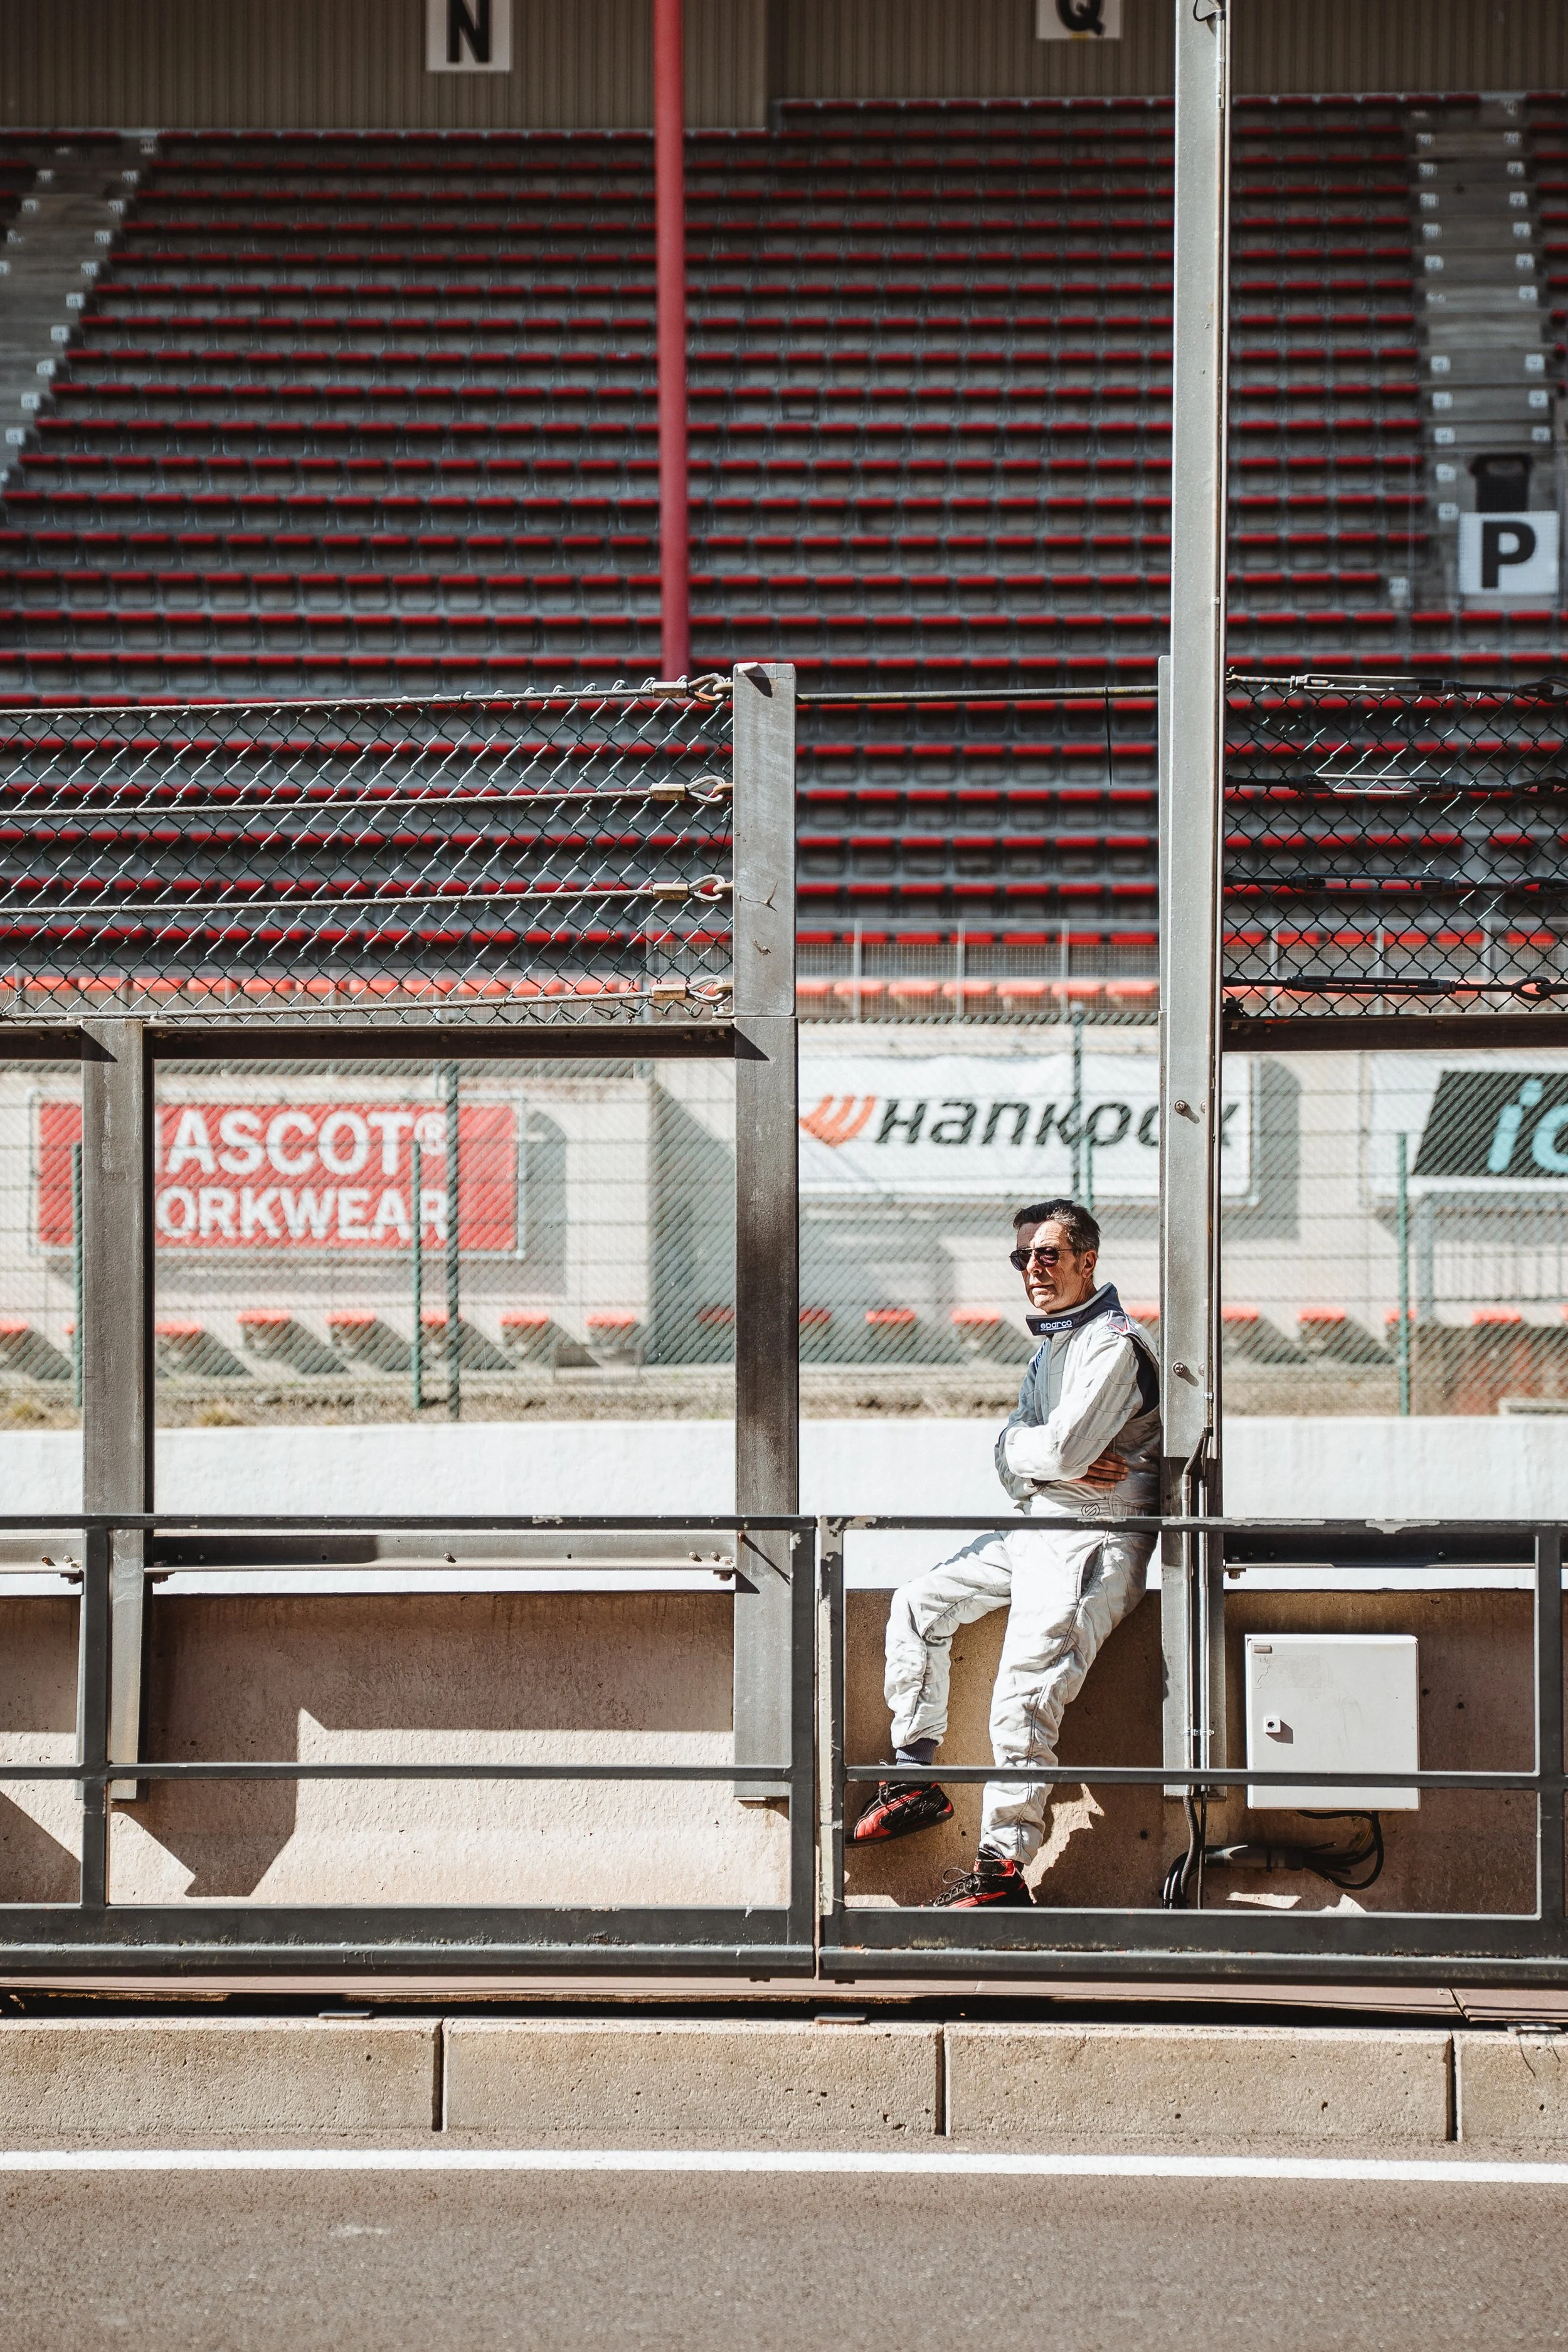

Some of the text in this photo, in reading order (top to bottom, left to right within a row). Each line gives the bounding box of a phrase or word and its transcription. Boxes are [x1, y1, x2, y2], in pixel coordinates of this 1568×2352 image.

[446, 0, 491, 64] N
[1056, 0, 1106, 36] Q
[1482, 521, 1536, 587] P
[156, 1185, 447, 1239] ORKWEAR
[1040, 1320, 1073, 1331] sparco
